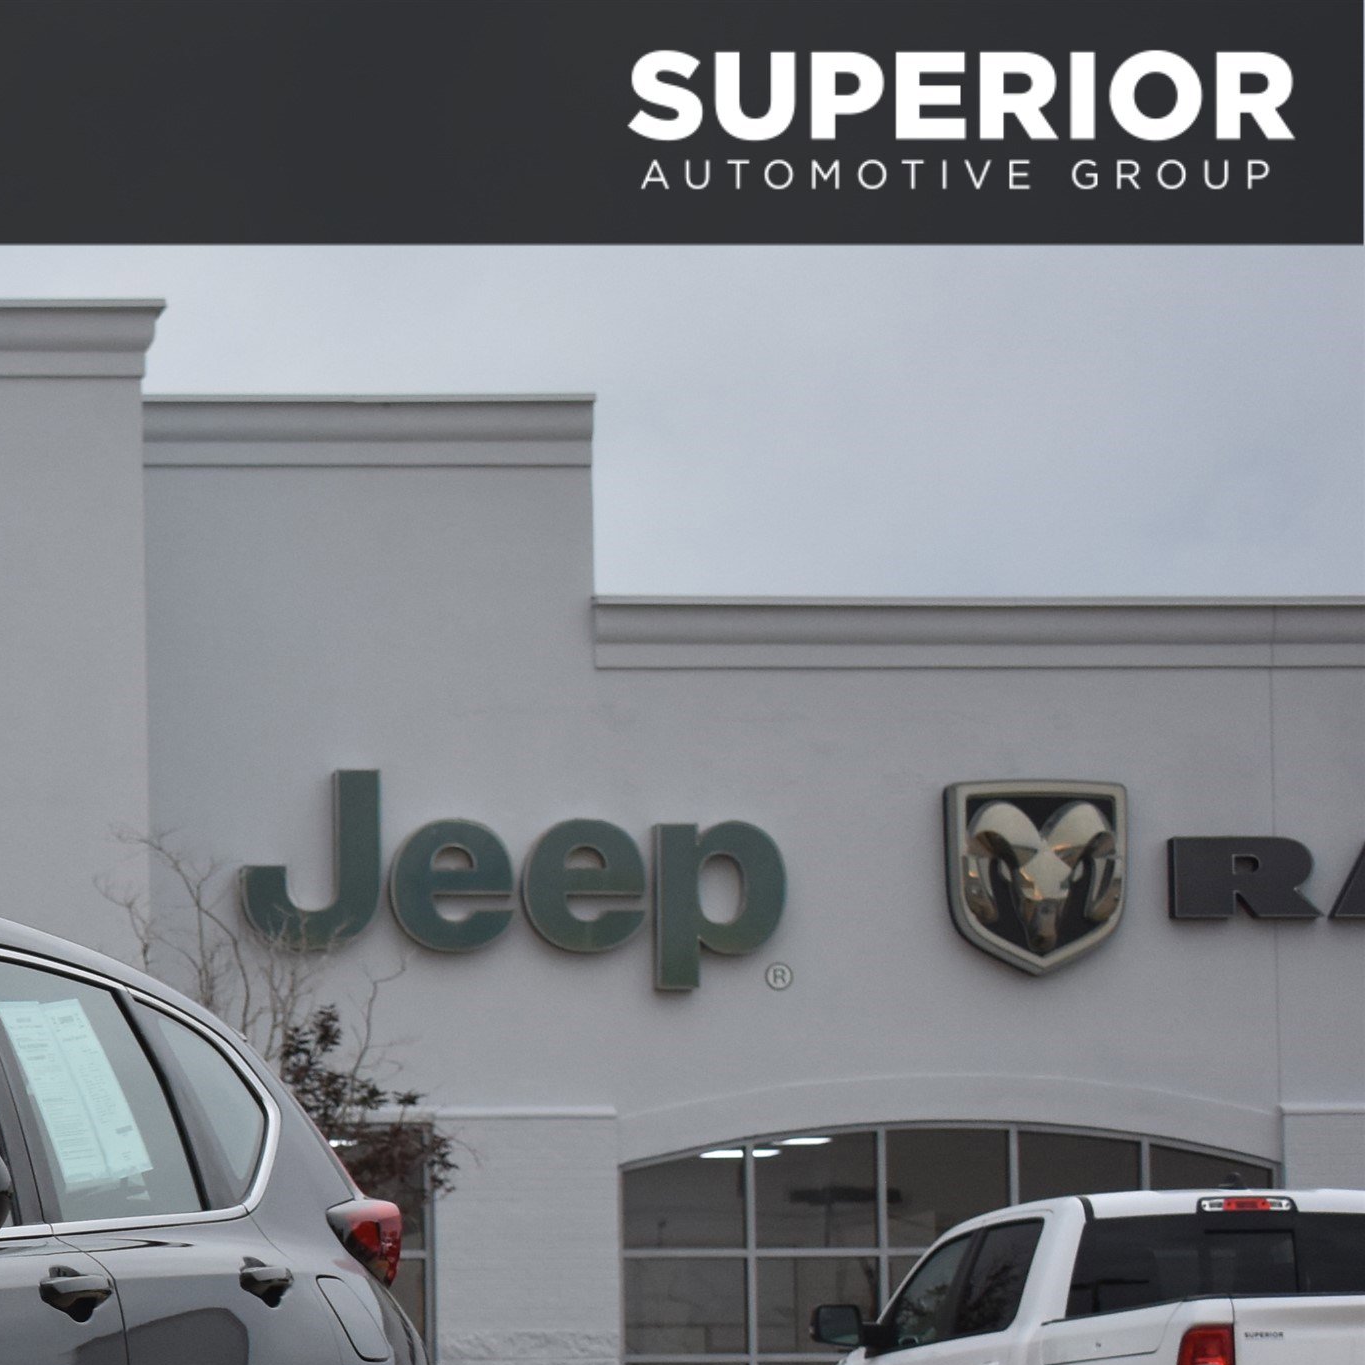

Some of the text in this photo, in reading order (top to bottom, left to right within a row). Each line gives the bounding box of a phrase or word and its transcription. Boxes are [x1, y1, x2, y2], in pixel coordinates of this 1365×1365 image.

[239, 768, 788, 992] Jeep
[1167, 835, 1365, 921] R
[1244, 1330, 1284, 1339] SUPERIOR
